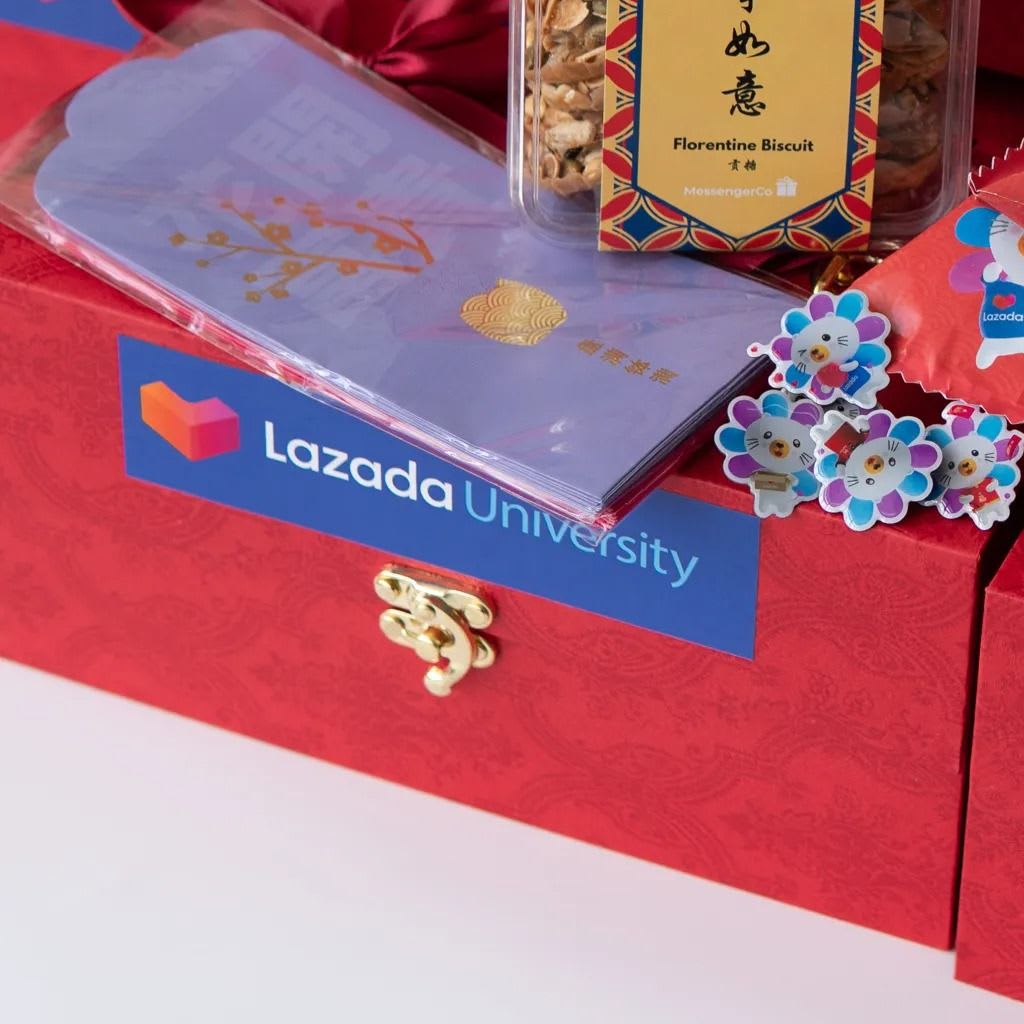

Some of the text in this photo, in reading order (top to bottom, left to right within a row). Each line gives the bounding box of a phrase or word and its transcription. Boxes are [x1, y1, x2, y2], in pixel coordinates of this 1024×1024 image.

[673, 137, 814, 152] Florentine Biscuit
[683, 186, 773, 198] MessengerCo
[983, 311, 1024, 322] Lazada
[264, 421, 699, 589] Lazada University
